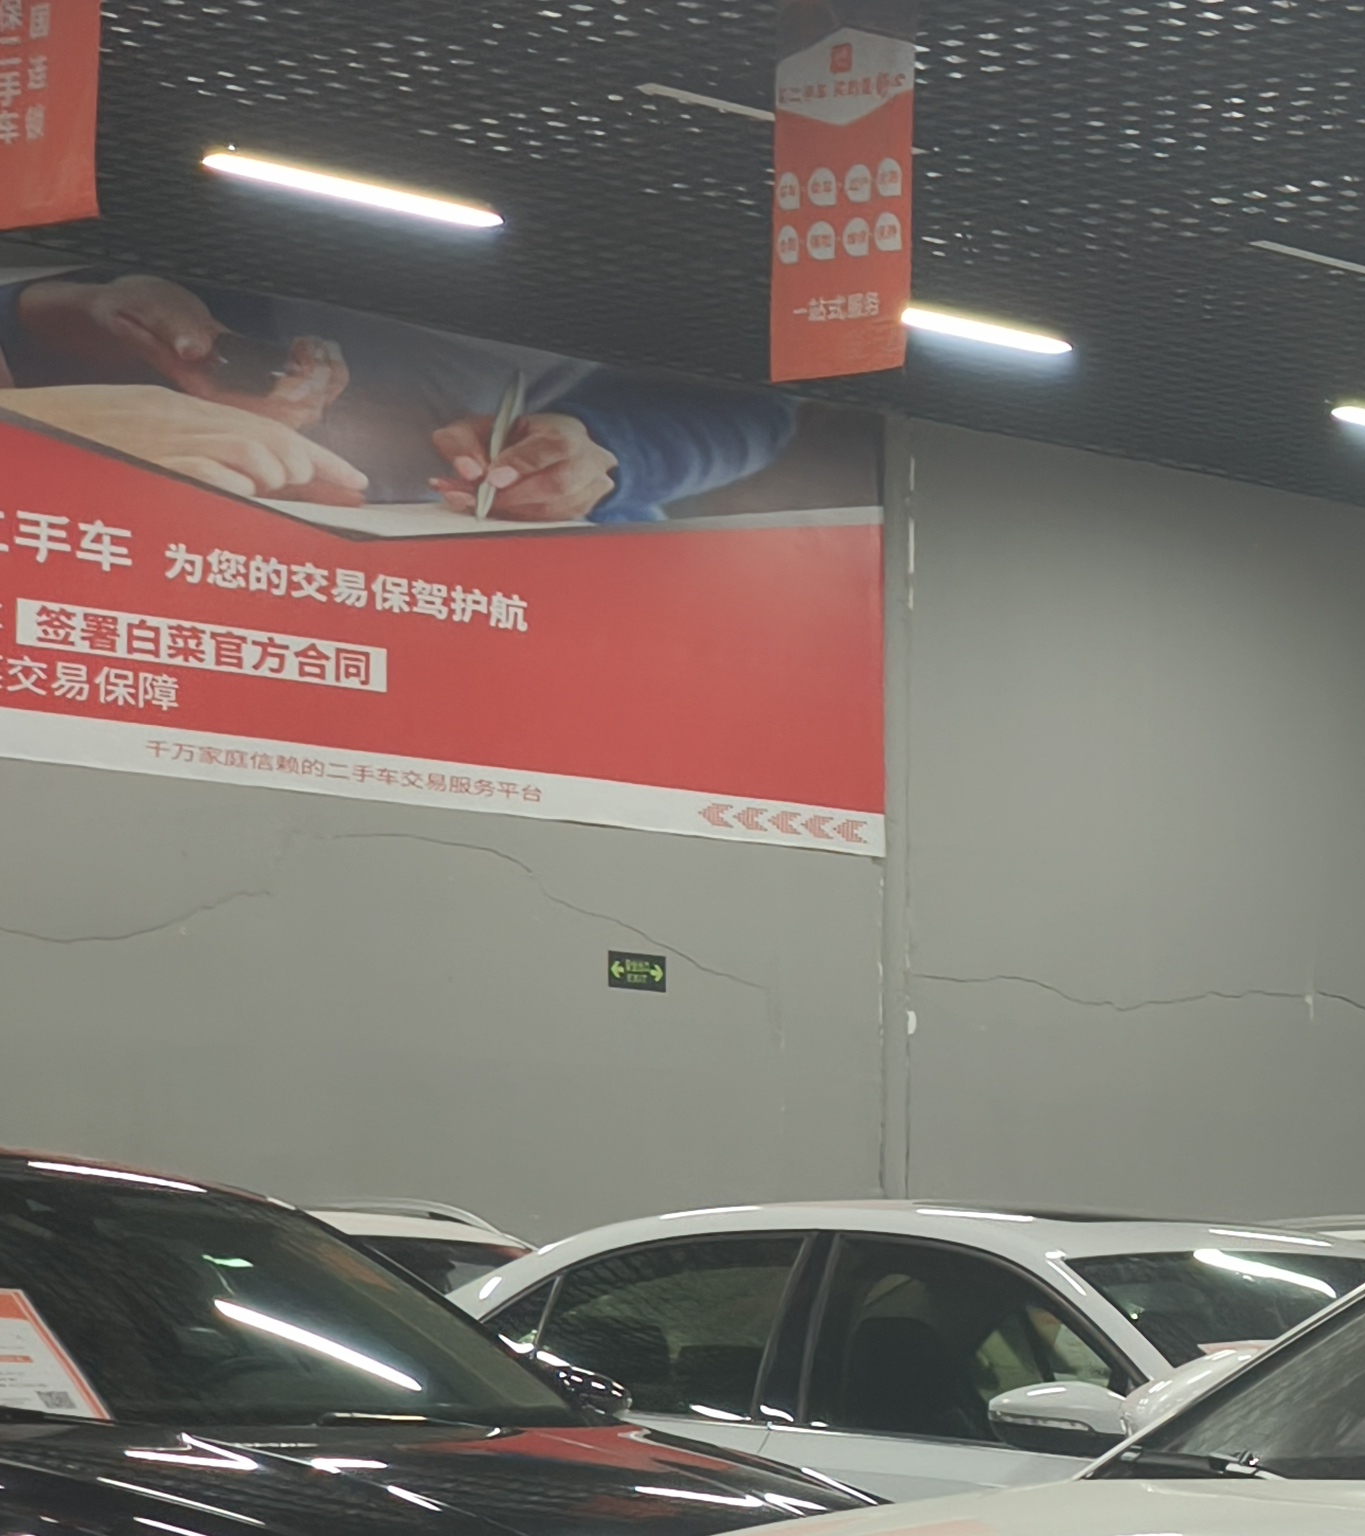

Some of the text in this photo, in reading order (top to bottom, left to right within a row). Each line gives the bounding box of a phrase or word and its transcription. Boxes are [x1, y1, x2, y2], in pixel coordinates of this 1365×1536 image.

[0, 510, 529, 632] 手车 为您的交易保驾护航
[36, 604, 371, 686] 签署白菜官方合同
[0, 655, 179, 711] 交易保障
[145, 739, 543, 802] 千万家庭信赖的二手车交易服务平台
